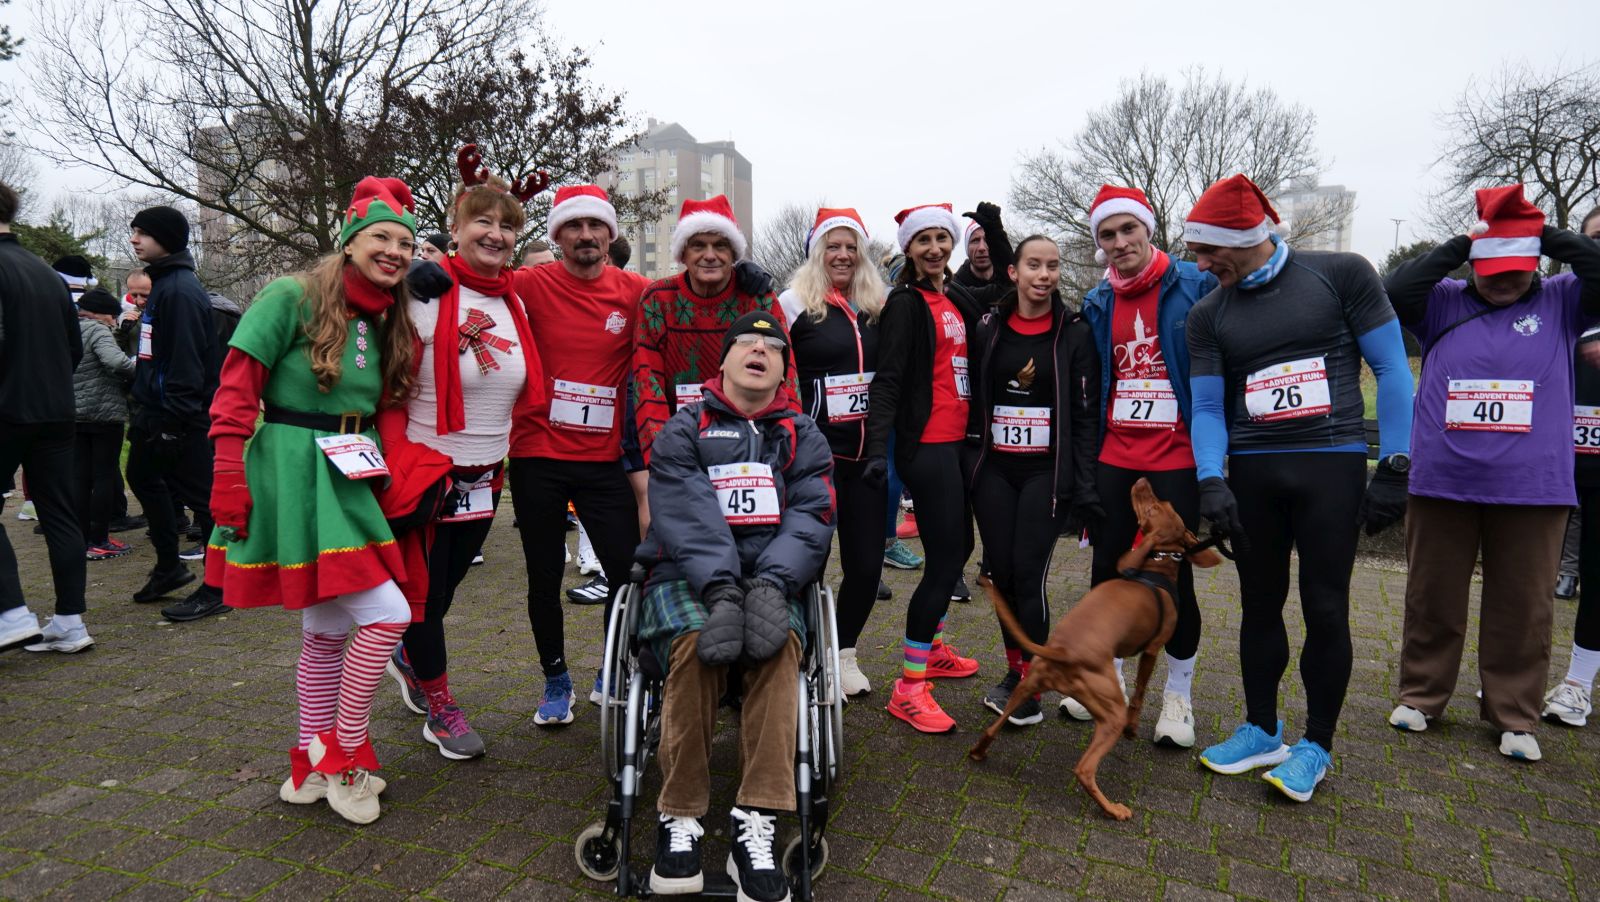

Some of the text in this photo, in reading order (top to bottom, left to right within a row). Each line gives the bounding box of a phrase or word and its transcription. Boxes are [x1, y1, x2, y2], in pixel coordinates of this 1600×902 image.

[848, 392, 869, 413] 25
[1271, 385, 1303, 411] 26
[581, 404, 590, 425] 1
[1130, 399, 1155, 420] 27
[1473, 401, 1504, 423] 40
[707, 430, 740, 439] LEGEA
[1002, 425, 1032, 446] 131
[1574, 425, 1600, 447] 39
[727, 488, 756, 514] 45
